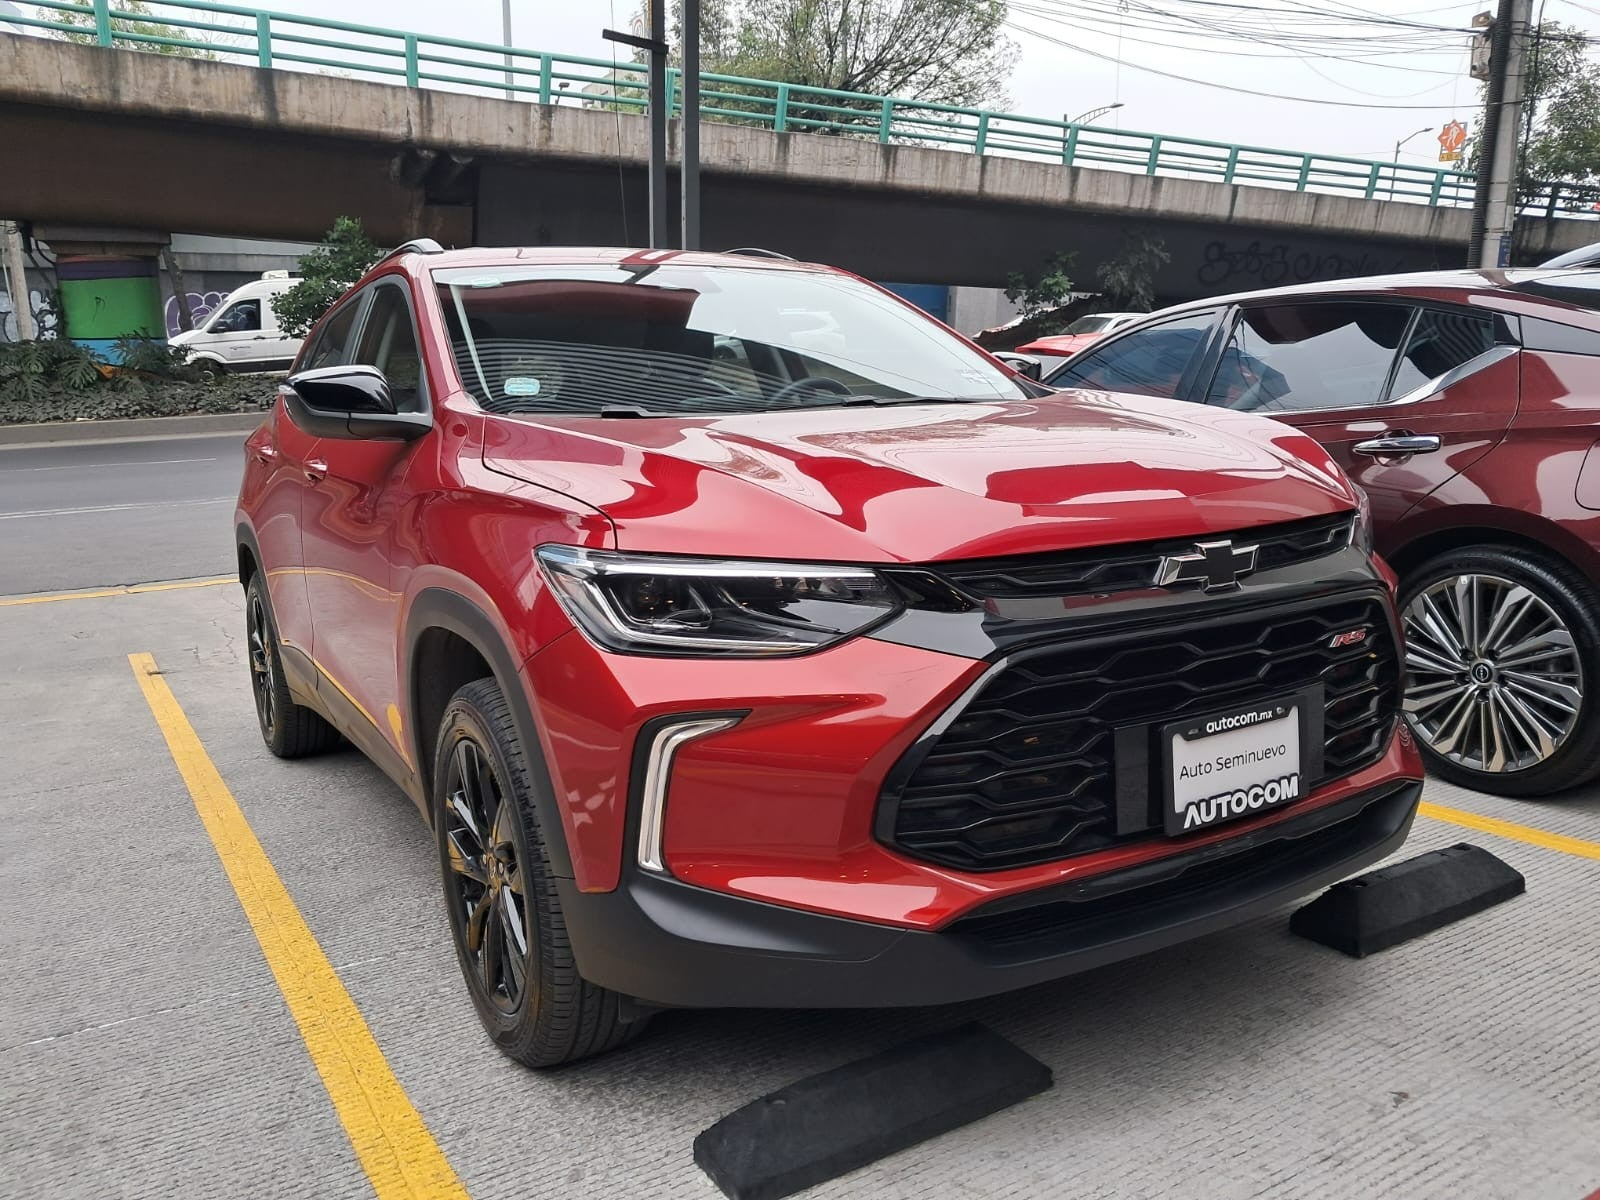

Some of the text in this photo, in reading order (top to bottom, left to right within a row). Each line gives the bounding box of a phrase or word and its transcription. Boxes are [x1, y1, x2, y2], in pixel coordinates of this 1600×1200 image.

[1206, 711, 1273, 733] autocom.mx
[1179, 743, 1286, 780] Auto Seminuevo
[1183, 775, 1299, 829] AUTOCOM
